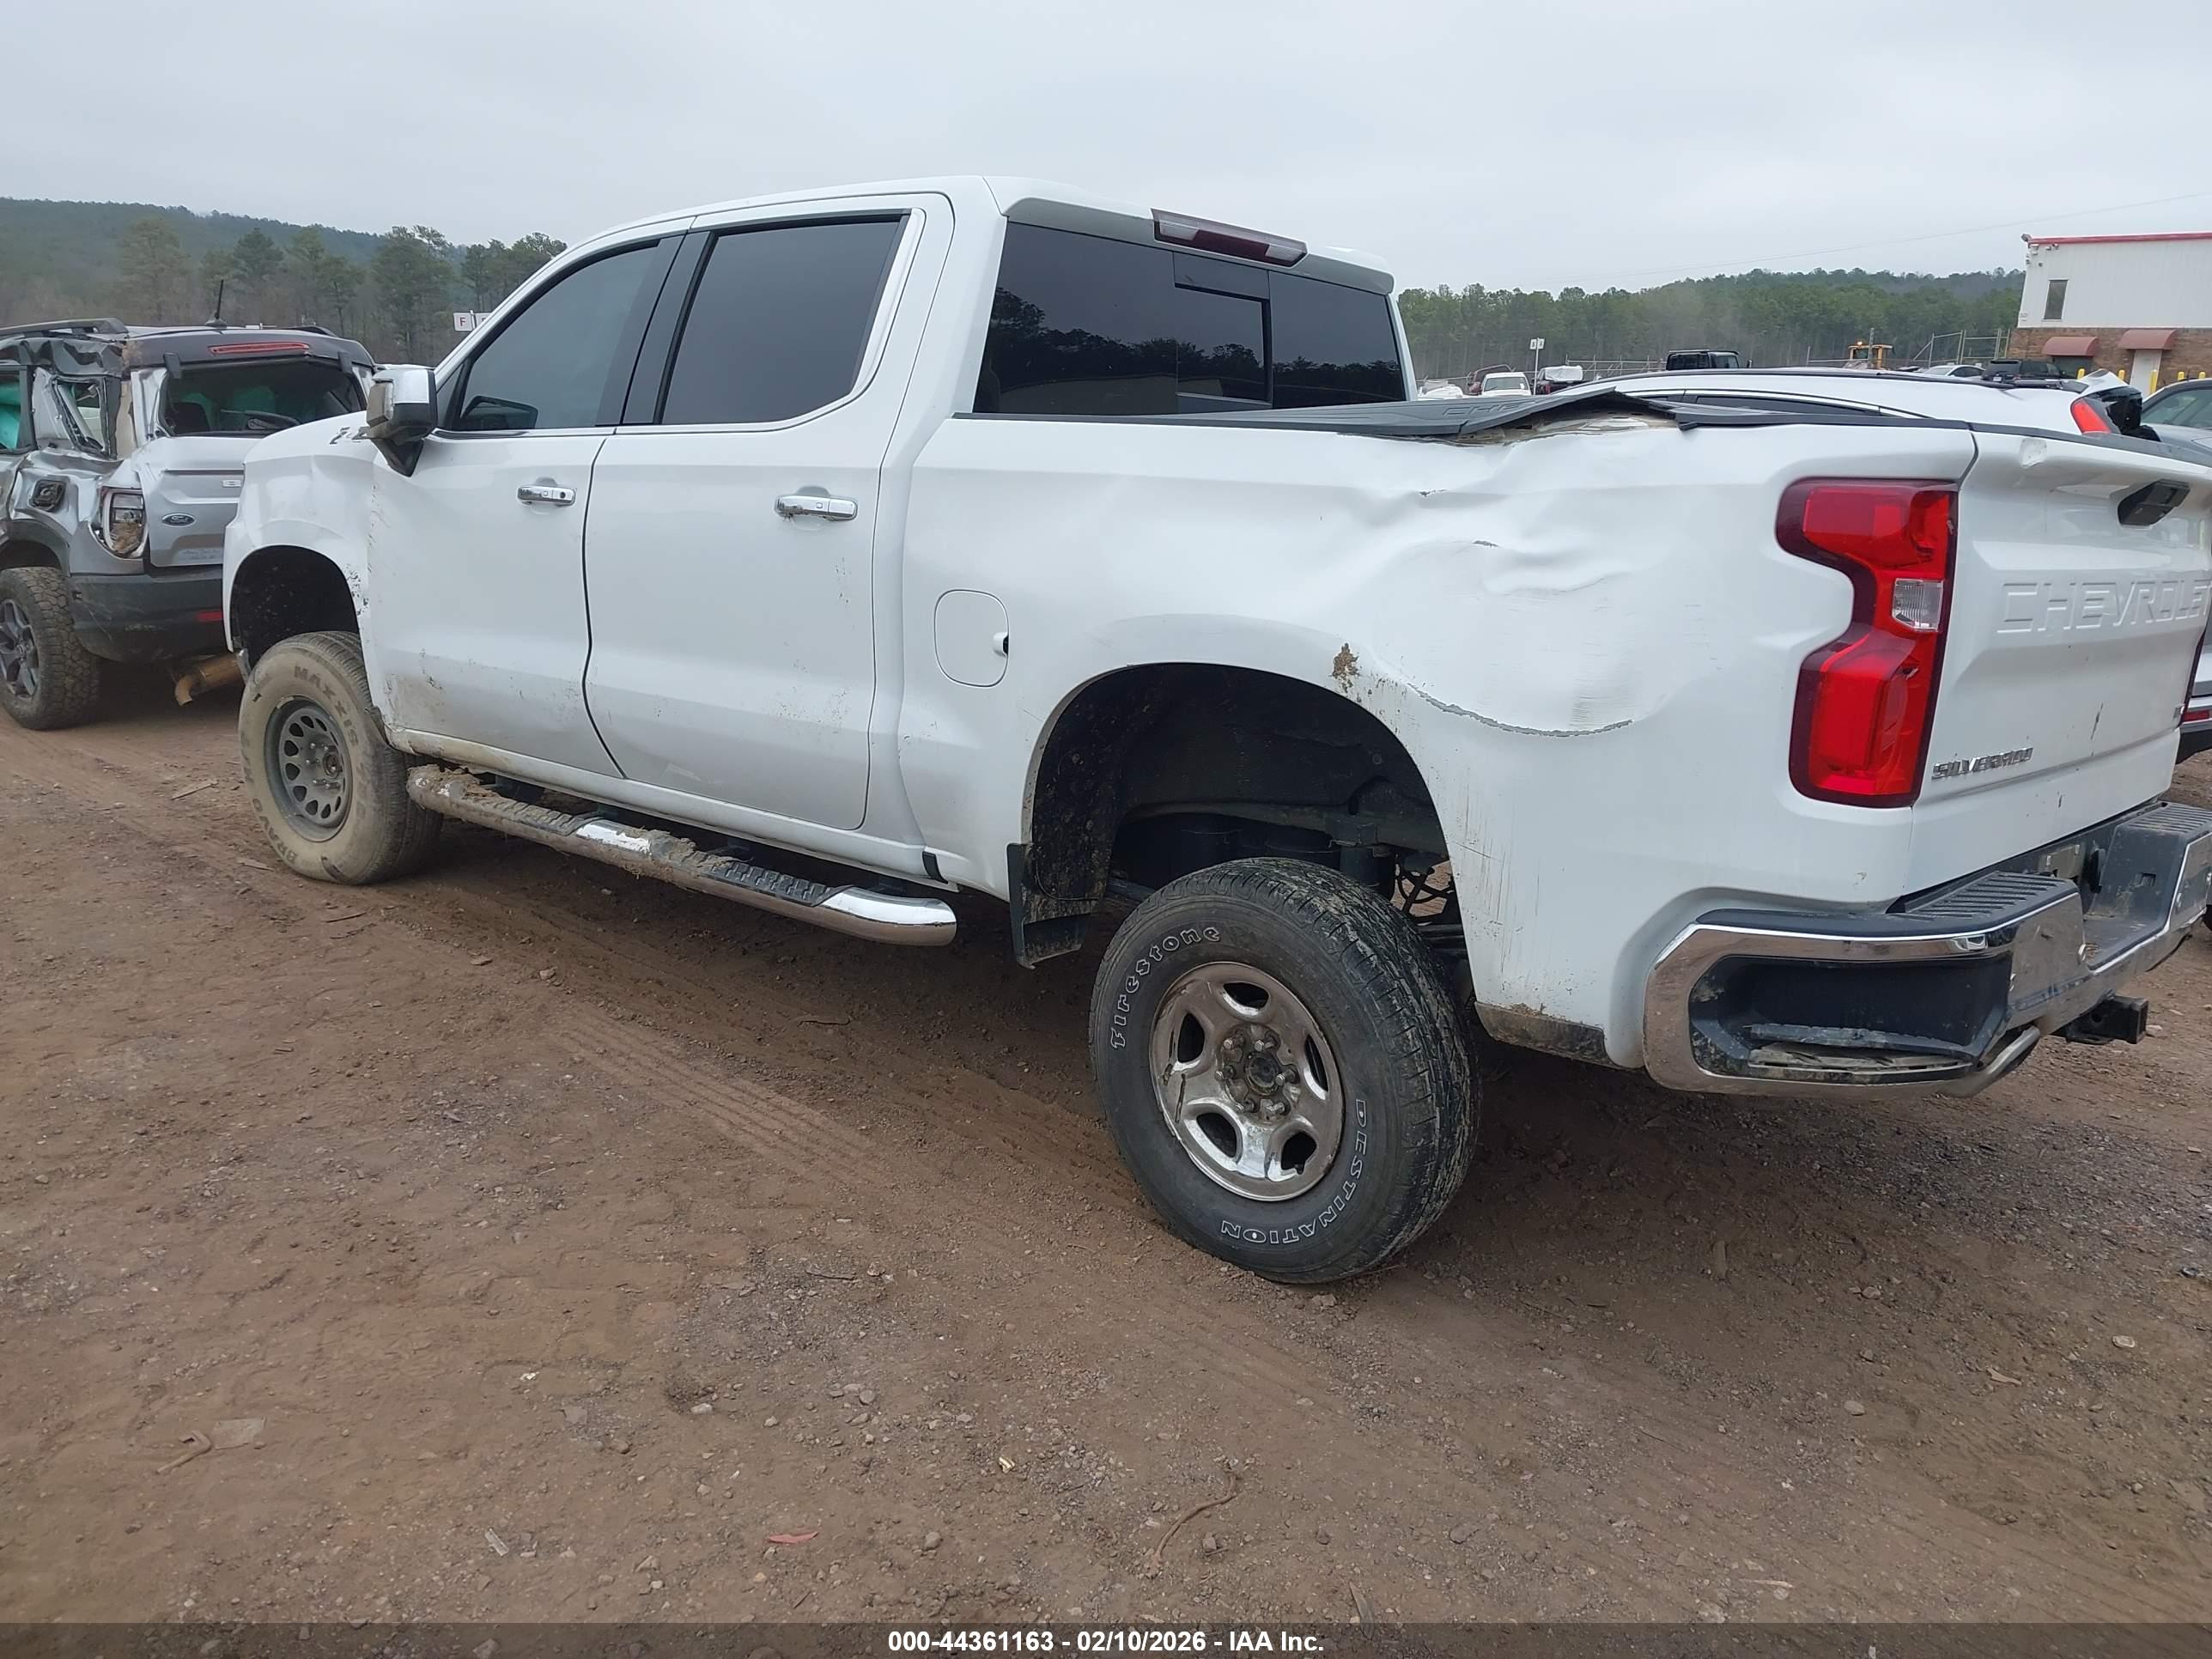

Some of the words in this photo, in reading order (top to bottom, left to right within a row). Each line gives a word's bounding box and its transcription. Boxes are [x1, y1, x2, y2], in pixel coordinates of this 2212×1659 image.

[459, 317, 466, 326] F
[294, 665, 359, 746] MAXXIS
[1220, 1098, 1367, 1245] DESTINATION
